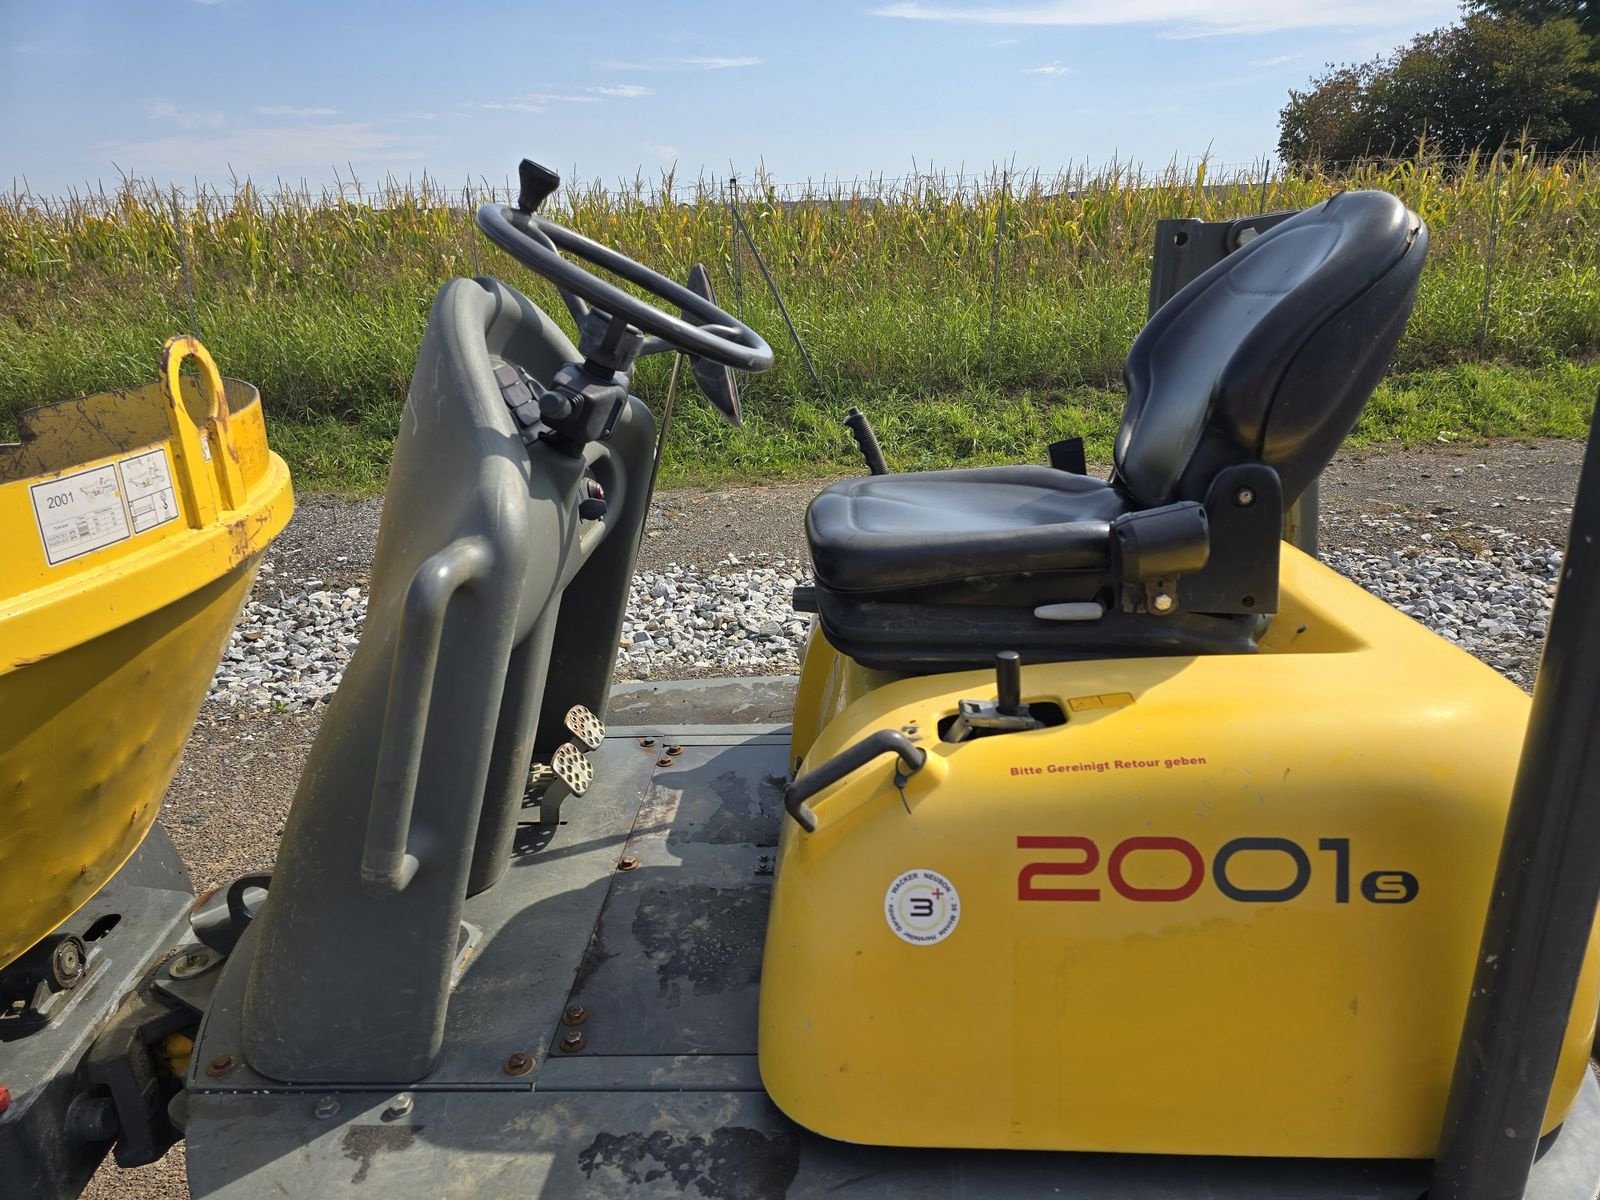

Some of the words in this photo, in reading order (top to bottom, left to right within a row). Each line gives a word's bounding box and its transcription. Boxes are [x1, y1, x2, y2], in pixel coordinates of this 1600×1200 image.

[46, 491, 75, 509] 2001
[1010, 766, 1042, 776] Bitte
[1047, 761, 1110, 773] Gereinigt
[1114, 758, 1161, 769] Retour
[1164, 756, 1207, 768] geben
[891, 872, 918, 894] WACKER
[923, 872, 952, 893] NEUSON
